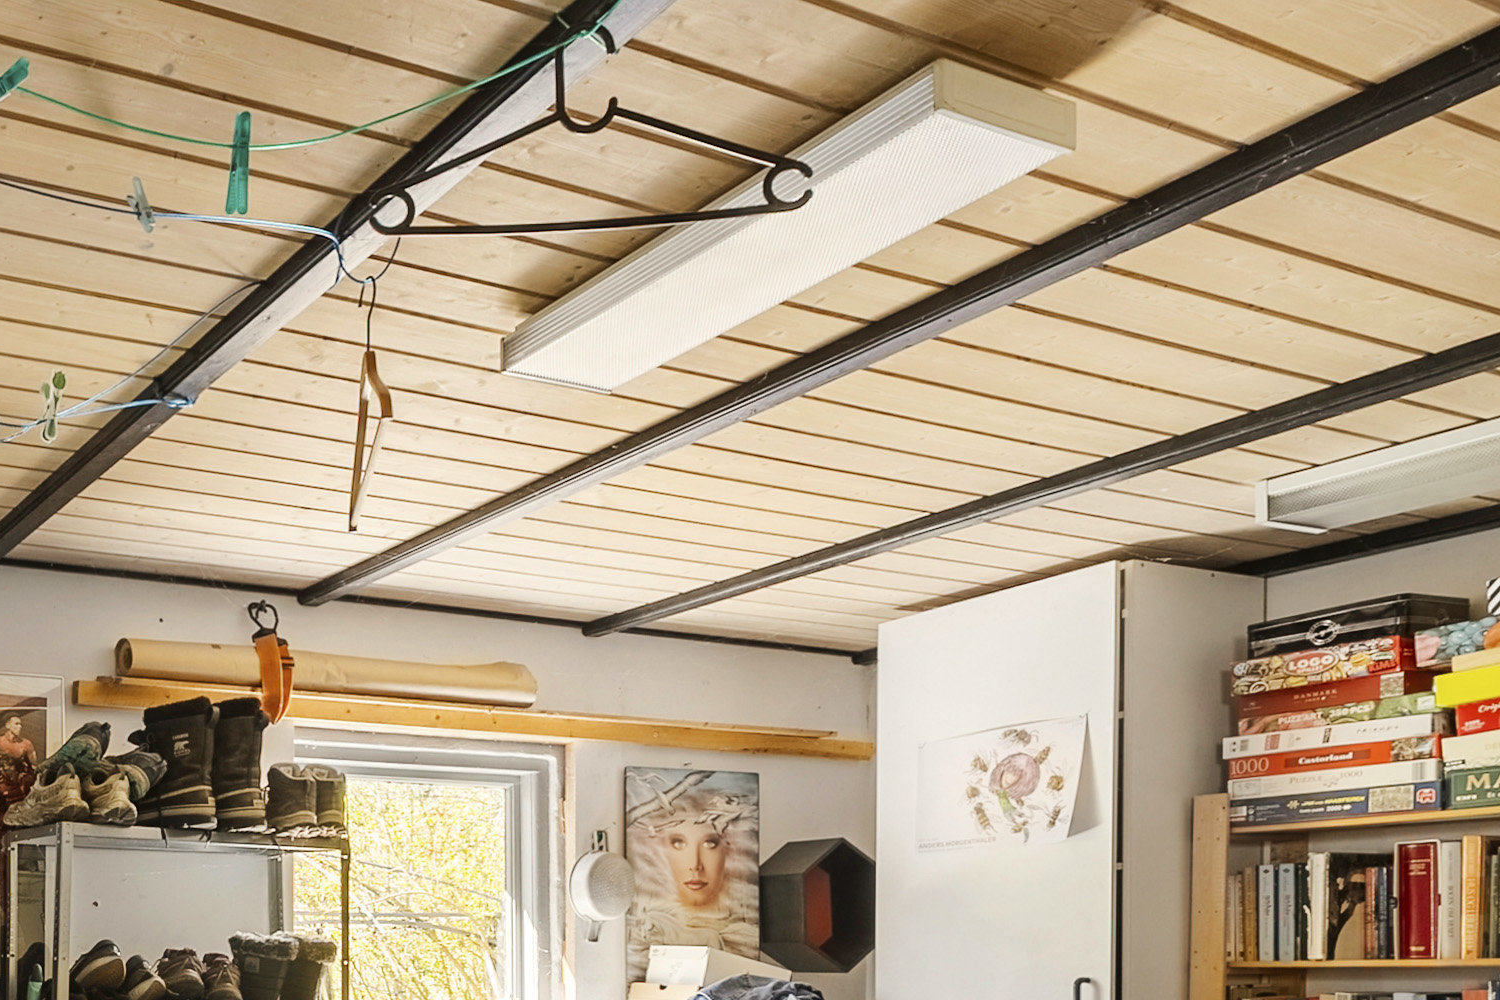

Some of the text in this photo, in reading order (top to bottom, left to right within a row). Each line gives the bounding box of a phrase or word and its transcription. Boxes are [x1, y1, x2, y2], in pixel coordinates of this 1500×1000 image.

[1288, 655, 1334, 671] LOGO
[1293, 689, 1338, 700] DANMARK
[1231, 752, 1354, 775] 1000 Castorland
